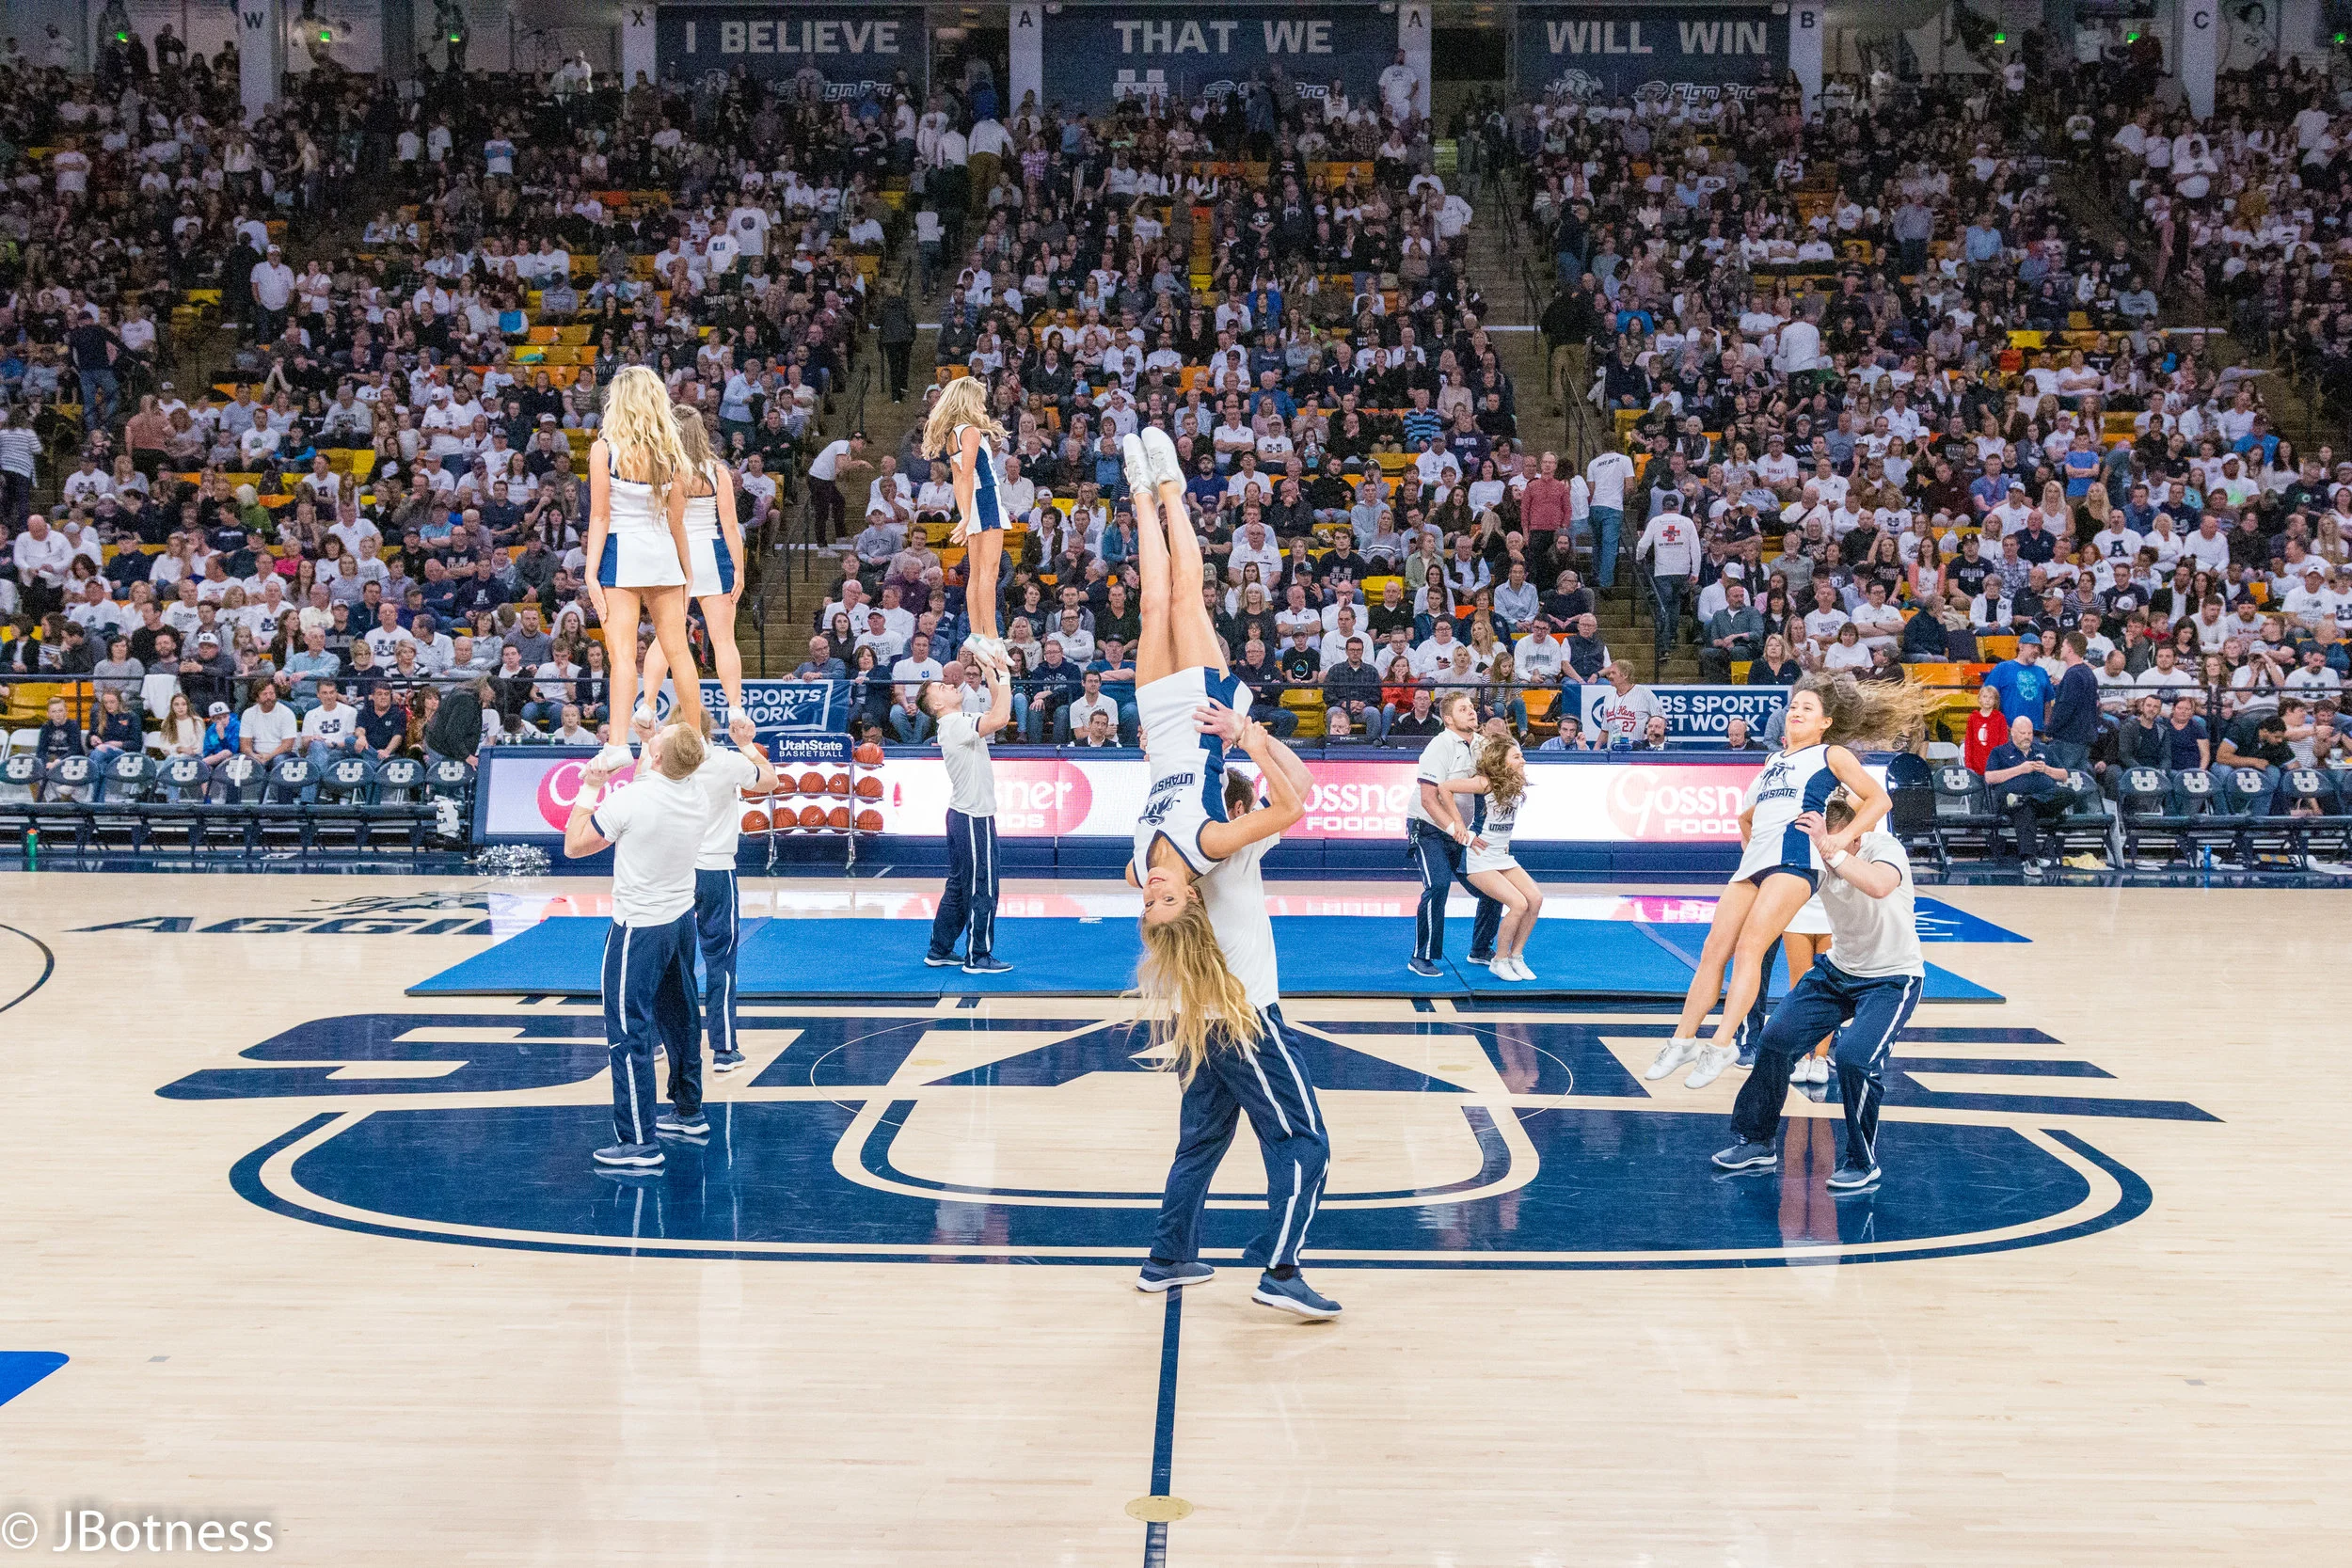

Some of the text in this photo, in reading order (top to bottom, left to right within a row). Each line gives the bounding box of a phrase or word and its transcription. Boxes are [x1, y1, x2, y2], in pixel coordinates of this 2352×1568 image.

[244, 11, 264, 29] W
[631, 9, 646, 27] X
[1017, 9, 1034, 28] A
[1407, 9, 1422, 28] A
[1800, 10, 1816, 29] B
[2192, 10, 2210, 29] C
[685, 21, 899, 54] I BELIEVE
[1113, 21, 1333, 54] THAT WE
[1547, 21, 1768, 55] WILL WIN
[700, 689, 731, 705] BS
[1661, 696, 1783, 714] BS SPORTS
[1622, 721, 1637, 733] 27
[779, 739, 844, 751] UtahState
[1769, 787, 1797, 799] STATE
[1306, 816, 1403, 832] FOODS
[1664, 818, 1740, 834] FOOD
